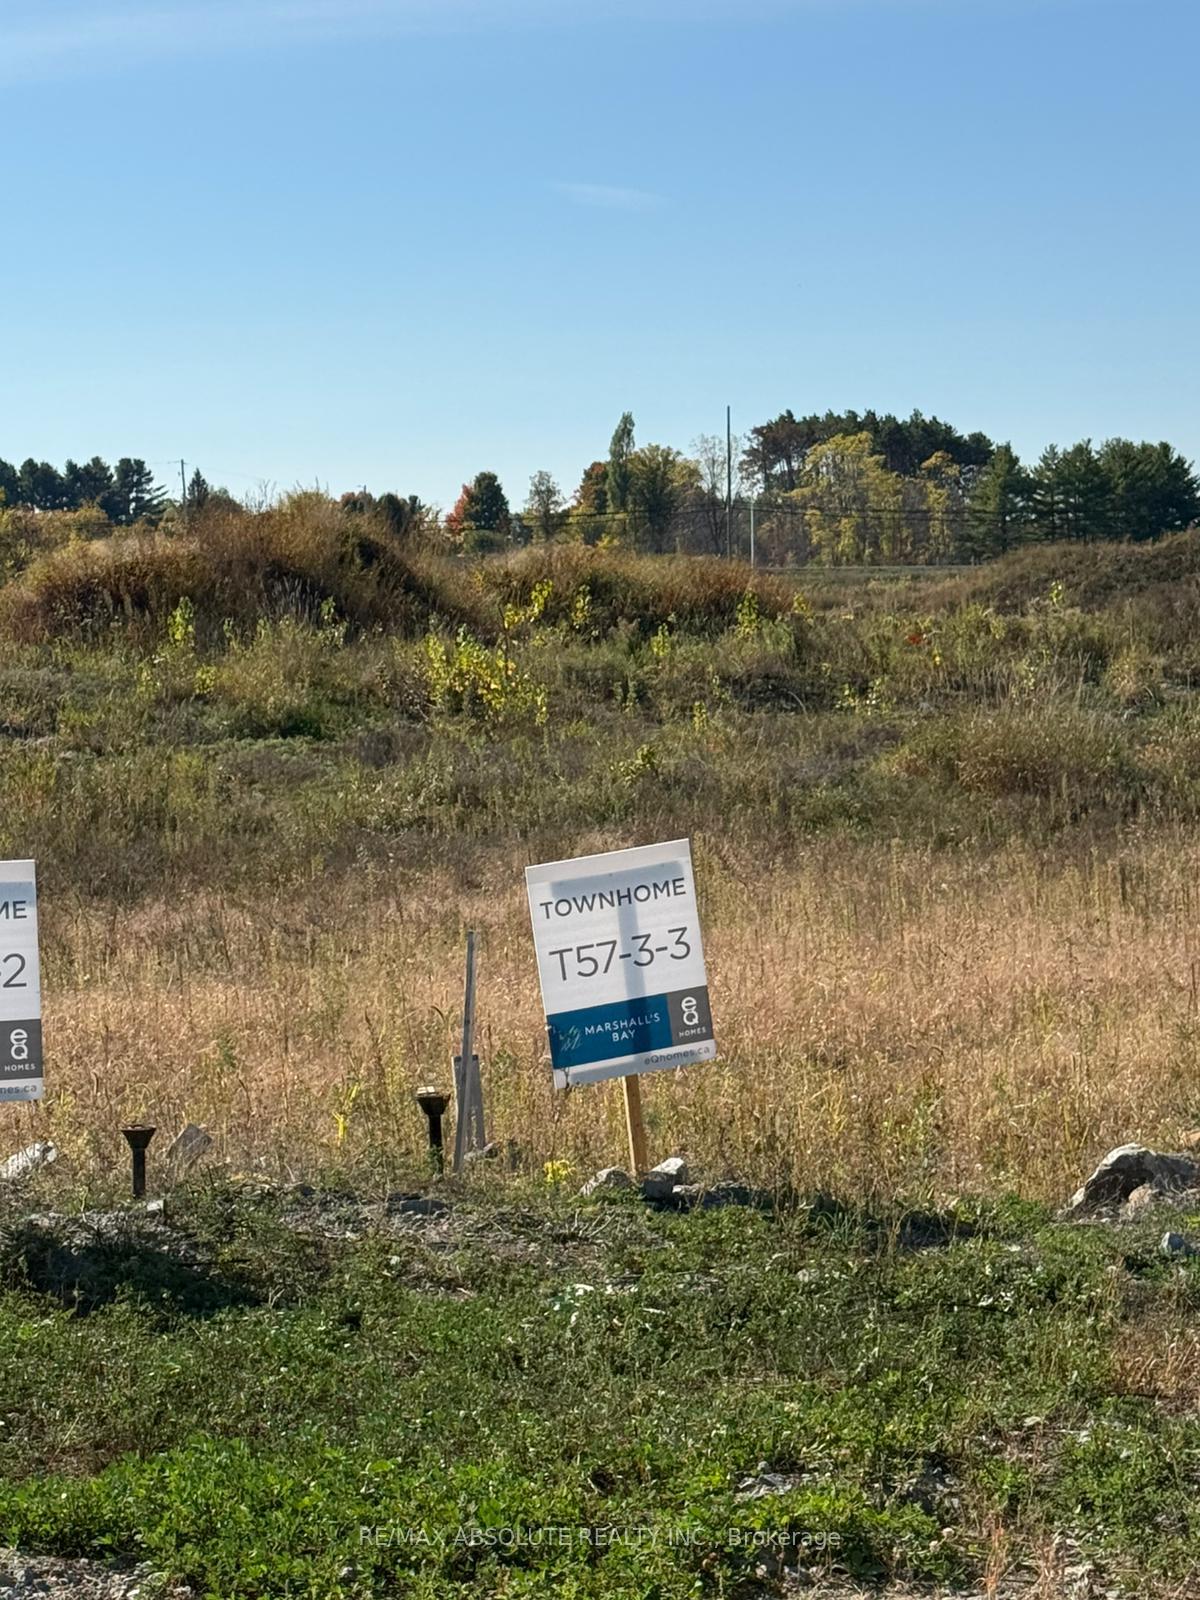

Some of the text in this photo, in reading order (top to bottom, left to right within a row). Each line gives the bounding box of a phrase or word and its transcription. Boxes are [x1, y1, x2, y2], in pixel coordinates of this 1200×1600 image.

[540, 877, 686, 920] TOWNHOME
[549, 926, 691, 982] T57-3-3
[0, 953, 27, 988] 2
[584, 1012, 661, 1036] MARSHALL'S
[679, 1026, 706, 1038] HOMES
[612, 1029, 636, 1042] BAY
[644, 1046, 710, 1065] eQhomes.ca
[4, 1063, 36, 1072] HOMES
